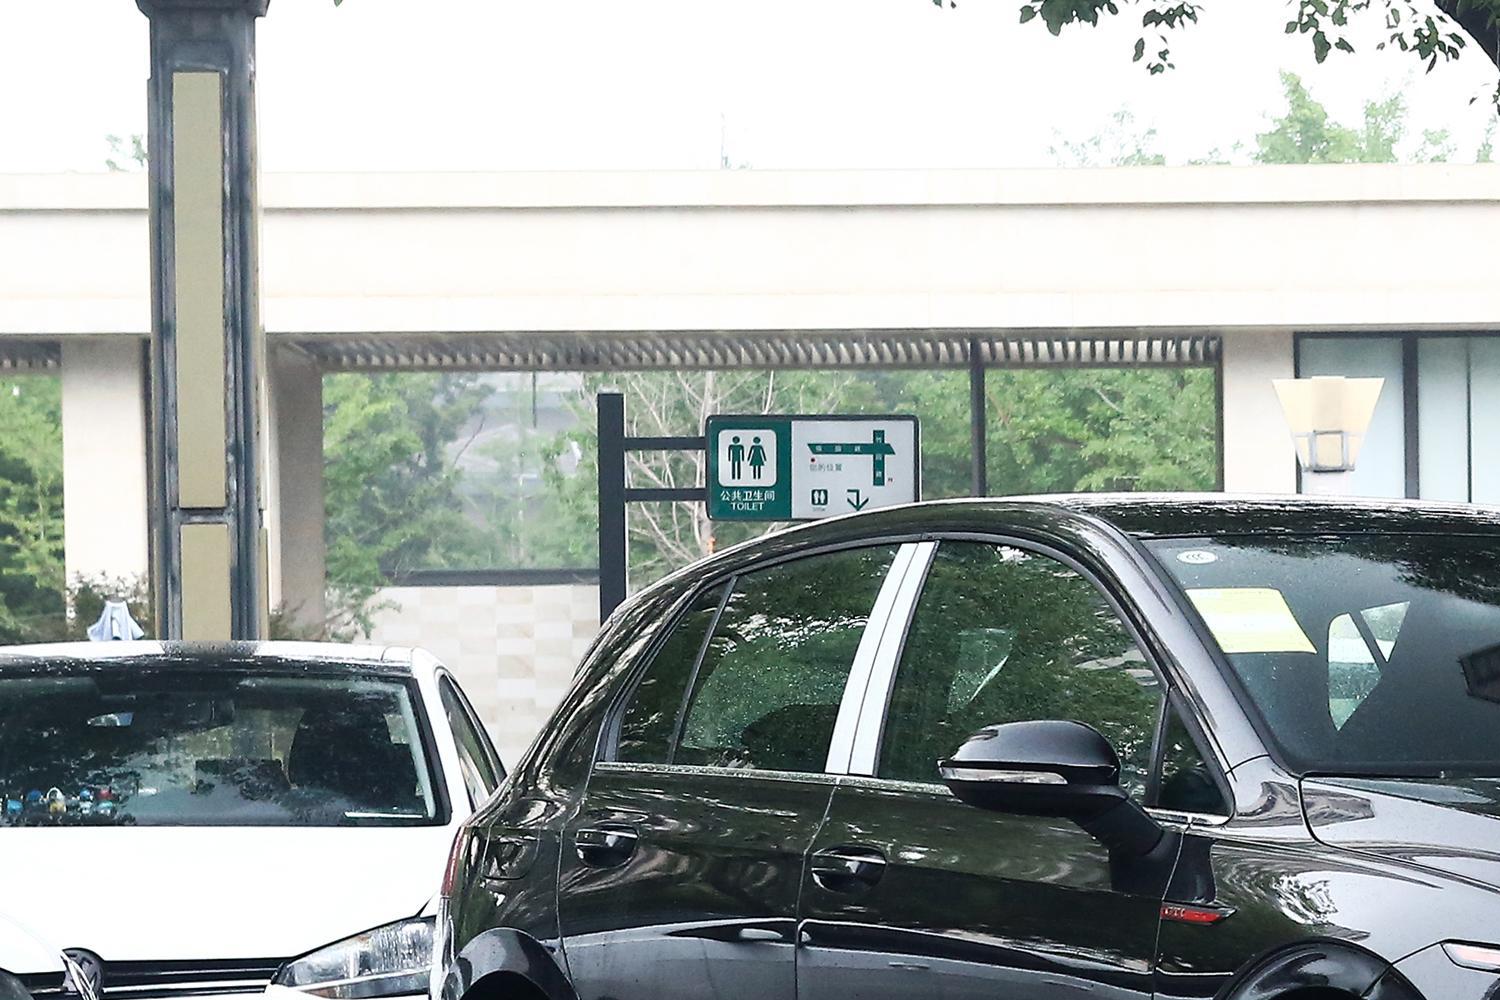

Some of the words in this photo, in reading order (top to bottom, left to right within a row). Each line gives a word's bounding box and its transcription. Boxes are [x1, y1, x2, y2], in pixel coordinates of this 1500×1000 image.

[719, 489, 776, 502] 公共卫生间
[730, 502, 765, 511] TOILET
